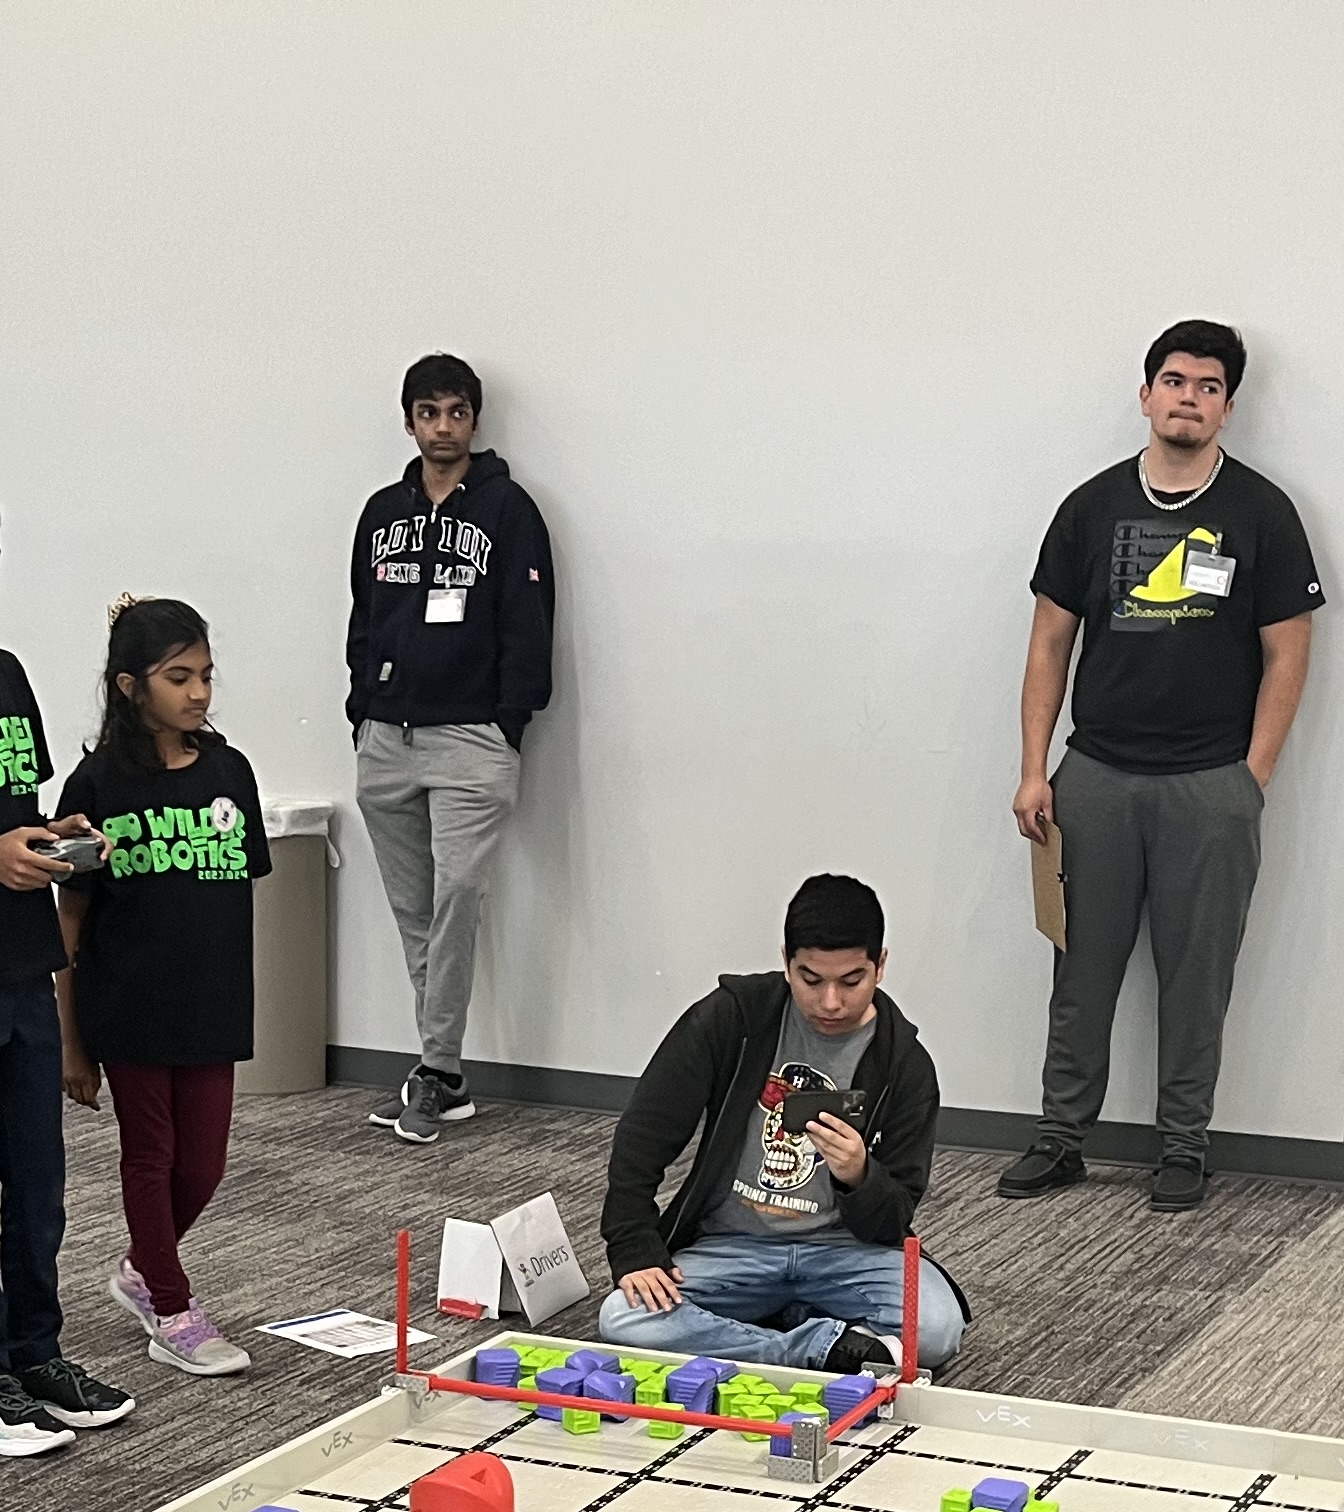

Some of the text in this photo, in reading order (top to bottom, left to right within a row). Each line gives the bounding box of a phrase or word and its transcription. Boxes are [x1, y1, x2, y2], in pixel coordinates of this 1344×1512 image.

[1112, 599, 1215, 625] Champion
[144, 806, 247, 841] WILDR
[109, 837, 248, 879] ROBOTICS
[769, 1193, 820, 1214] TRAINING
[529, 1245, 570, 1277] Drivers
[975, 1404, 1032, 1429] VEX
[321, 1430, 354, 1458] VEX
[217, 1482, 256, 1512] VEX
